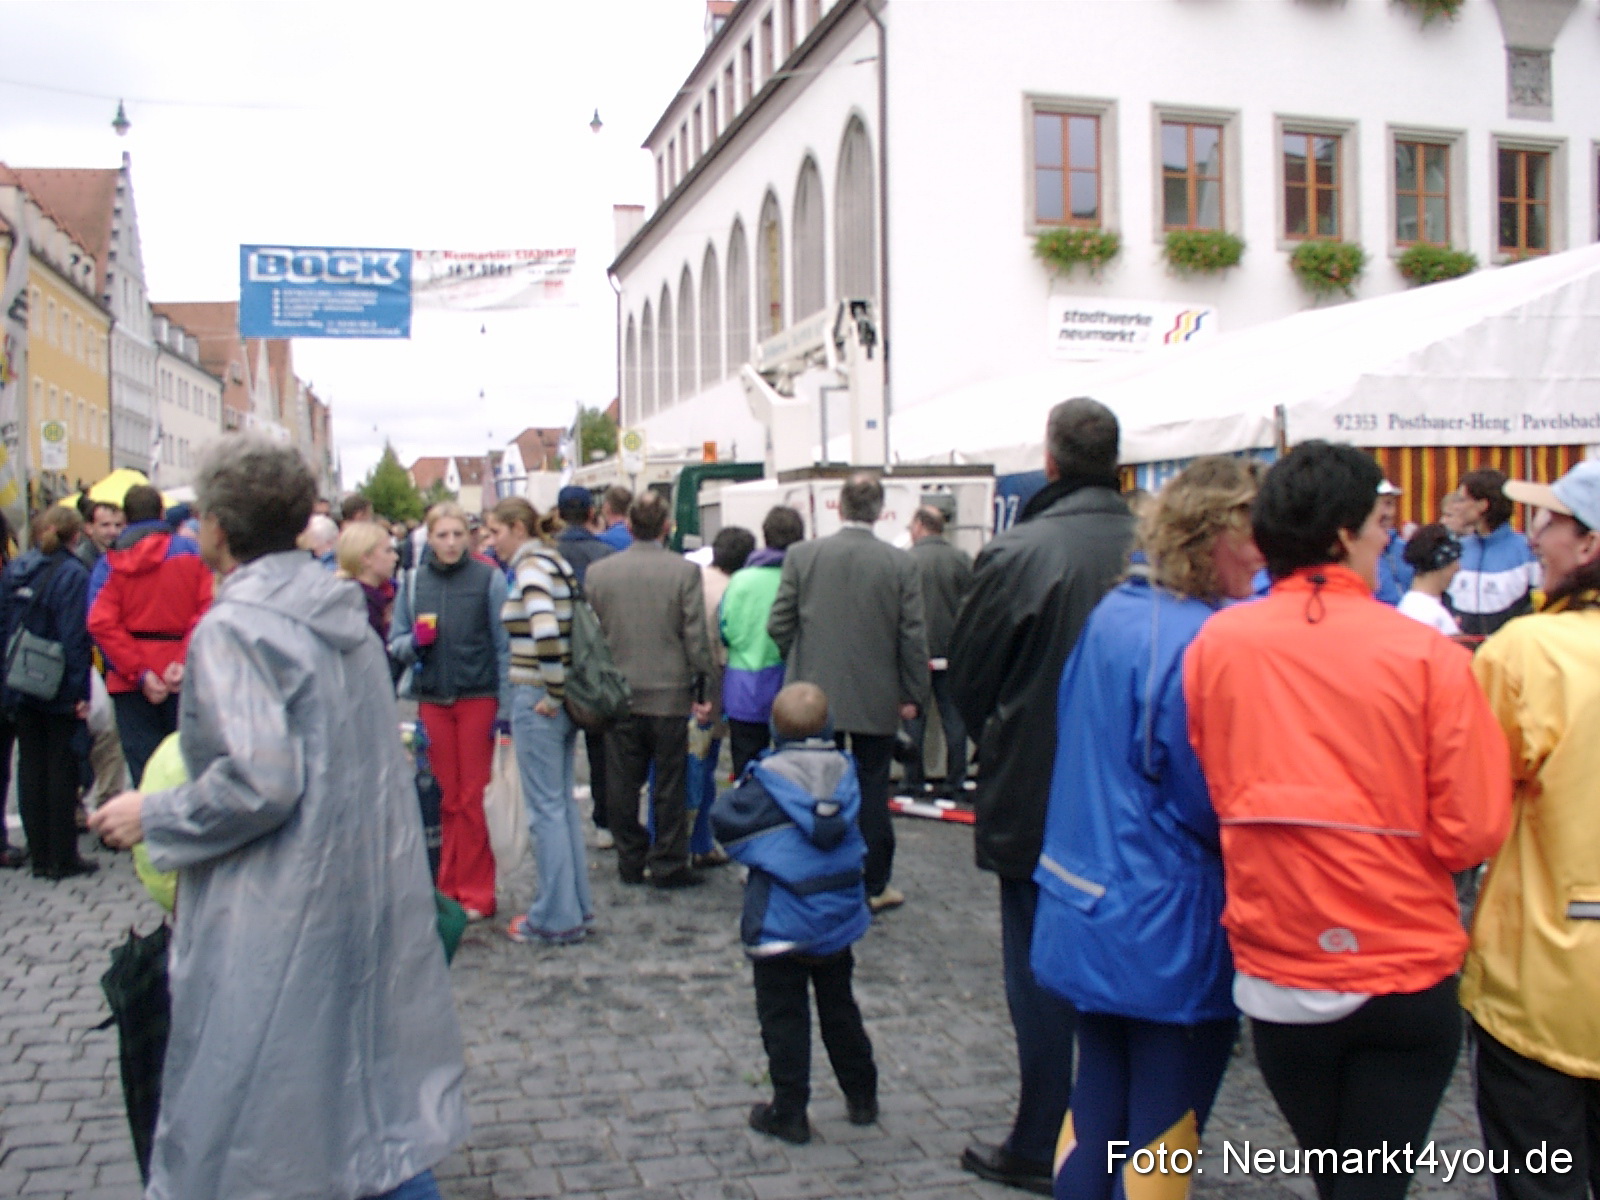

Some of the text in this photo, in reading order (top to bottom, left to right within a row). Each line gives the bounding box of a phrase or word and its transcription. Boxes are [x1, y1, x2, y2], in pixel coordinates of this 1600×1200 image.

[248, 248, 401, 286] BOCK
[1063, 310, 1152, 326] stadtwerke
[1058, 328, 1136, 343] neumarkt
[1334, 414, 1378, 431] 92353
[1388, 413, 1511, 433] Postbauer-Heng
